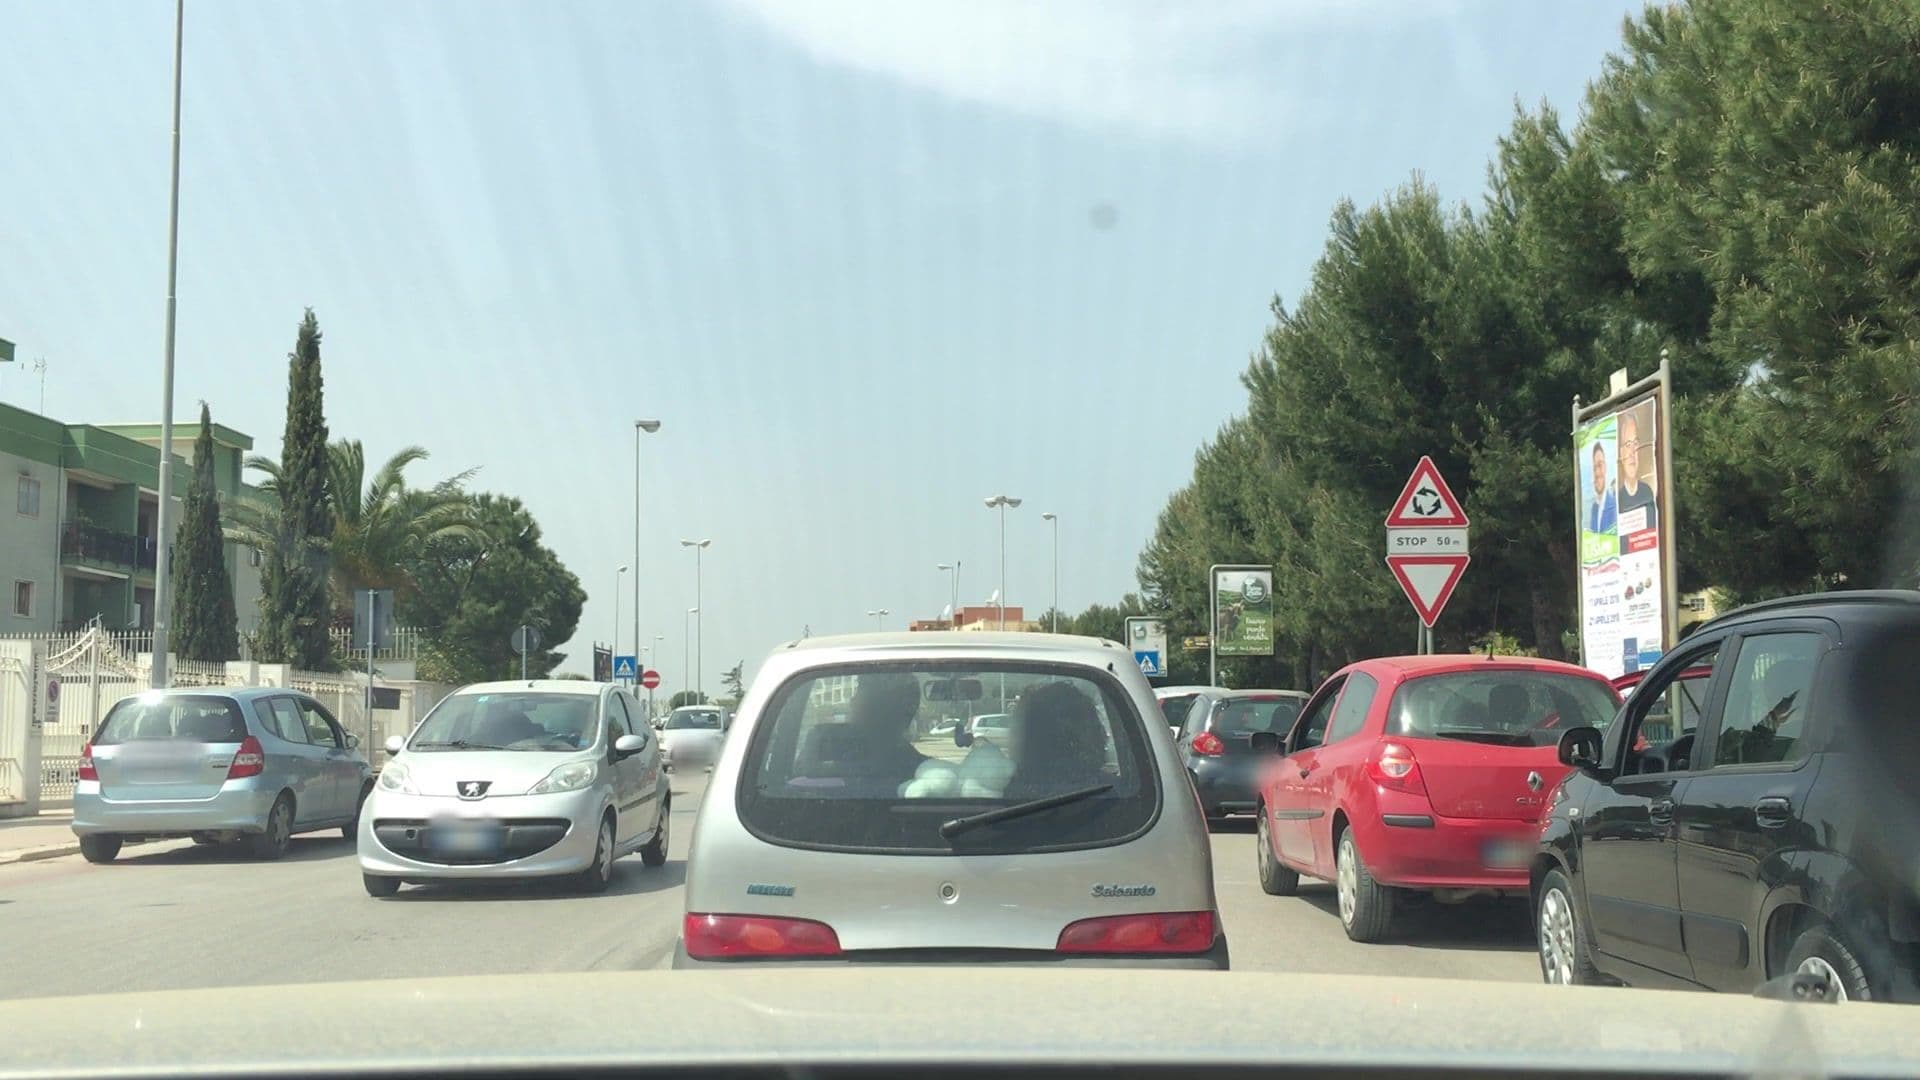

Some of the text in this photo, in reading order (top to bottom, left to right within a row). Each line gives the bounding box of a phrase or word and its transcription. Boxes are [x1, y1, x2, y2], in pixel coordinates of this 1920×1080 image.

[1396, 537, 1427, 546] STOP
[1437, 536, 1450, 546] 50
[1516, 797, 1543, 805] CLI
